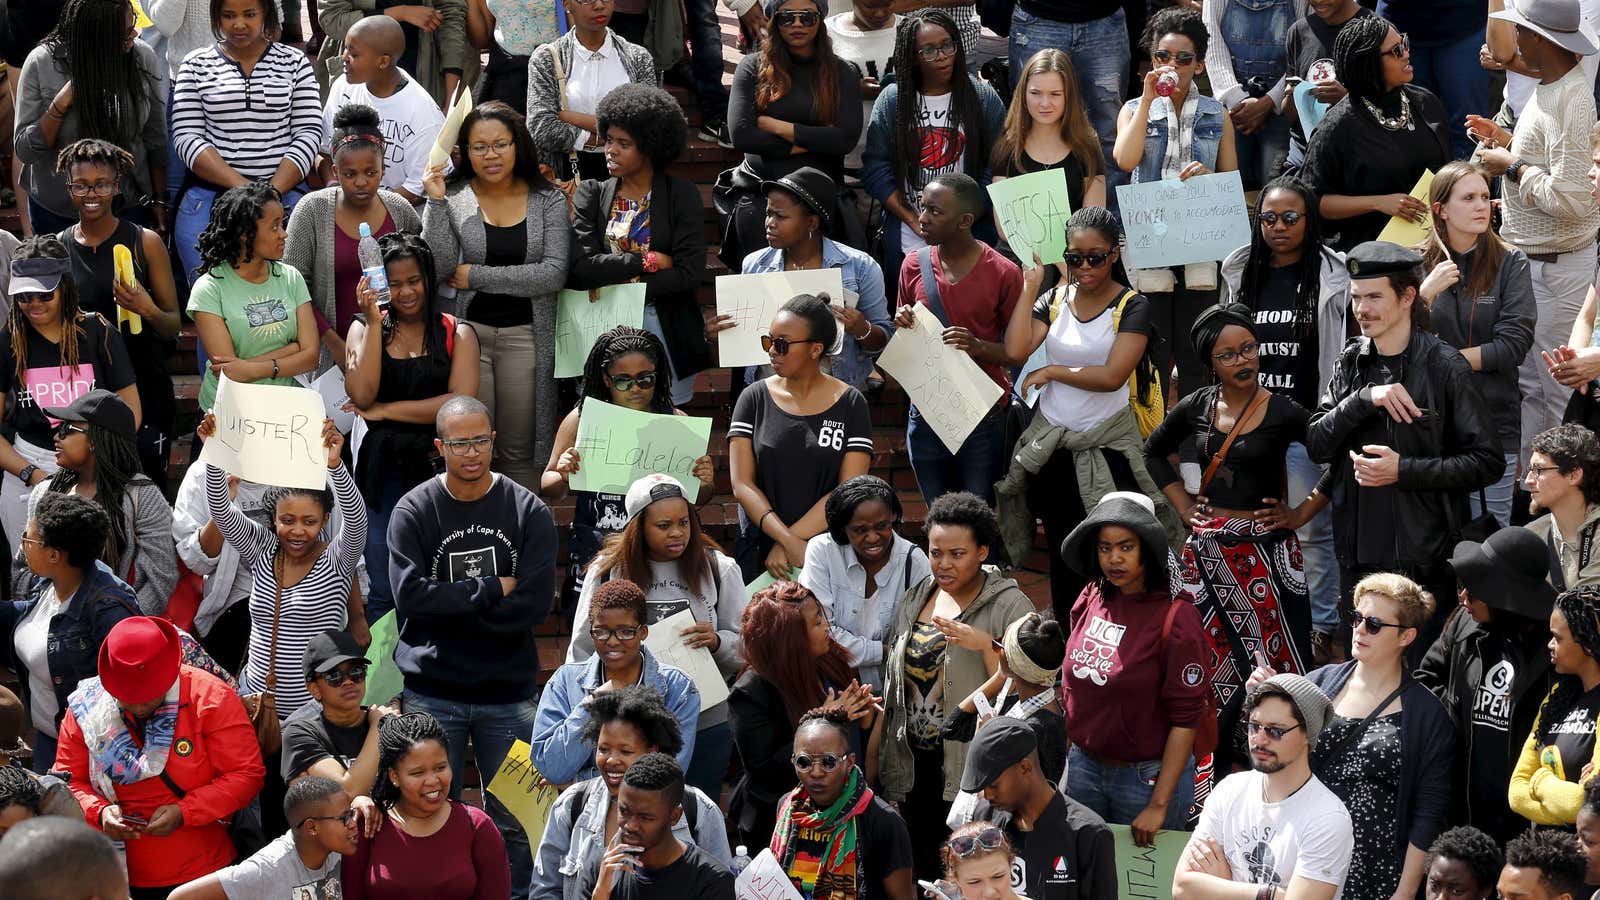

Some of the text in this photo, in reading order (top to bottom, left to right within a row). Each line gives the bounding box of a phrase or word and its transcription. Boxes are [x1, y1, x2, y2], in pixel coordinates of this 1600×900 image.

[1128, 206, 1168, 225] POWER
[1257, 371, 1295, 389] FALL
[219, 392, 320, 465] LUISTER
[818, 427, 845, 452] 66
[576, 423, 698, 479] #Lalela
[466, 524, 475, 535] of
[476, 525, 495, 536] Cape
[495, 528, 513, 548] Town
[1582, 537, 1591, 567] DIGITAL
[1087, 617, 1125, 645] UCT
[1069, 647, 1114, 674] SCIENCE
